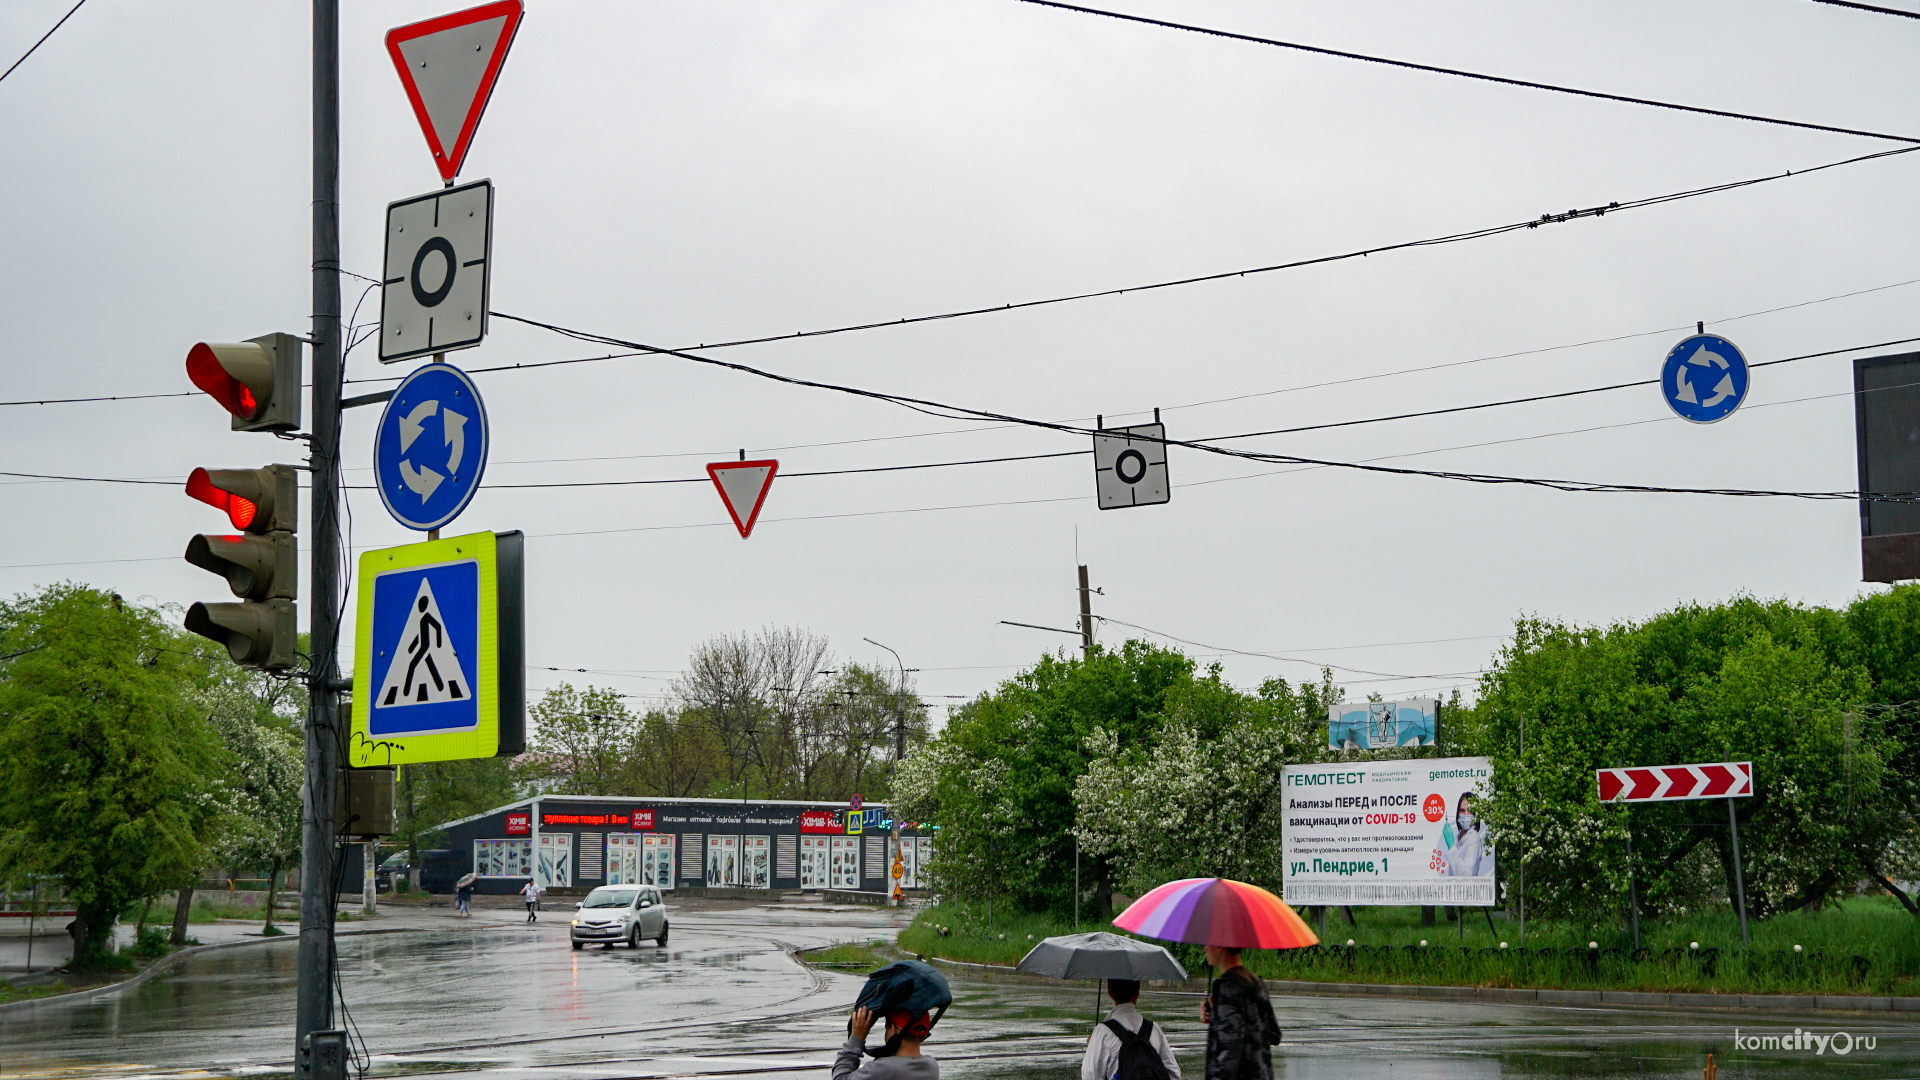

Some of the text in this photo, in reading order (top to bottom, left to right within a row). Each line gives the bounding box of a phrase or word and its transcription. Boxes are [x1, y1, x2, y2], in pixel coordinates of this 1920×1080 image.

[1288, 772, 1366, 786] ГЕМОТЕСТ
[1429, 768, 1487, 781] gemotest.ru
[1289, 795, 1418, 809] Анализы ПЕРЕД и ПОСЛЕ
[1424, 806, 1444, 814] -30%
[1289, 812, 1416, 828] вакцинации от COVID-19
[893, 867, 902, 875] 40
[1290, 857, 1389, 876] ул. Пендрие, 1
